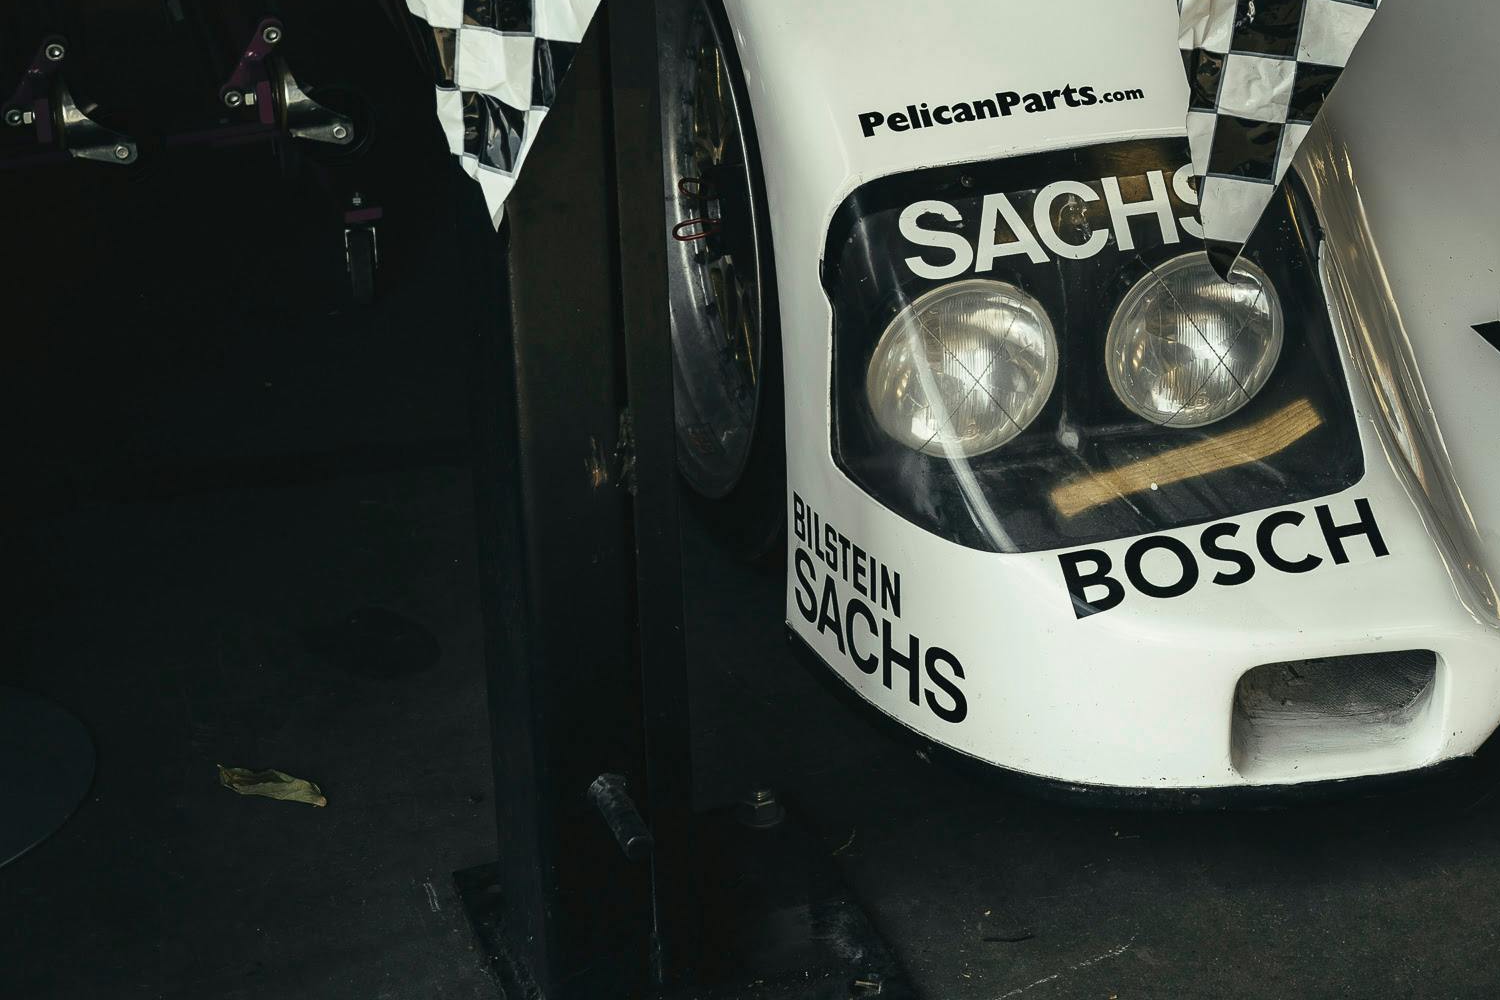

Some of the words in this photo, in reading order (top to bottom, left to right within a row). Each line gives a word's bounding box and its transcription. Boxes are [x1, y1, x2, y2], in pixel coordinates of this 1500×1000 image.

[858, 81, 1144, 138] PelicanParts.com
[792, 490, 904, 618] BILSTEIN
[1058, 497, 1390, 619] BOSCH
[793, 555, 969, 724] SACHS
